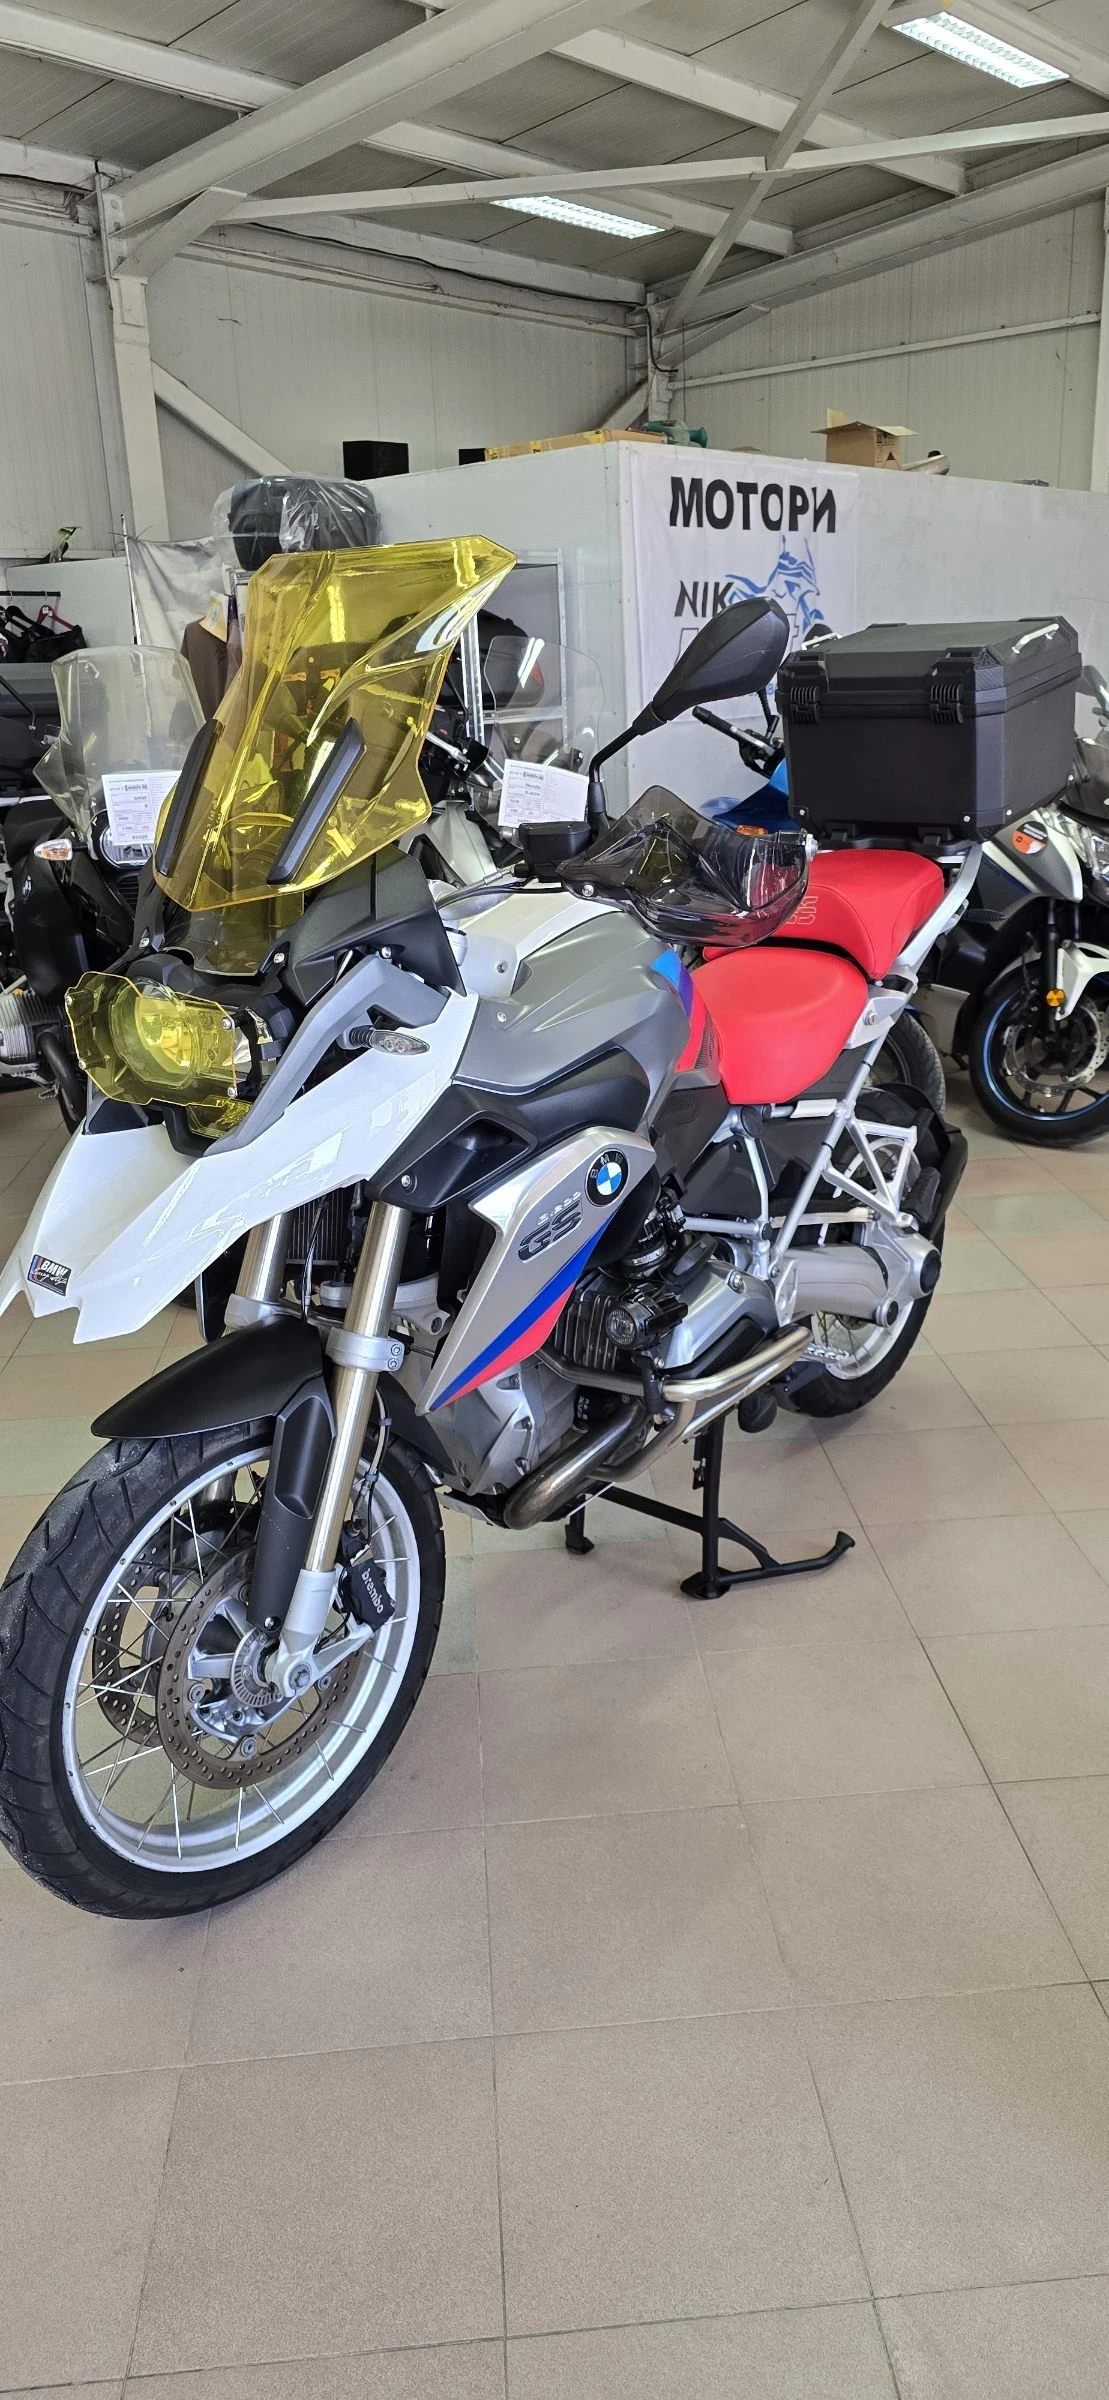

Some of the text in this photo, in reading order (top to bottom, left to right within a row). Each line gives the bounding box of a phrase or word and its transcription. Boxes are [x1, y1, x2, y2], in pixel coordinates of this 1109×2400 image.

[669, 476, 836, 533] МОТОРИ
[674, 580, 734, 618] NIK
[591, 1153, 624, 1179] BMW
[518, 1200, 582, 1261] GS
[41, 1260, 69, 1277] BMW
[361, 1568, 384, 1613] brembo
